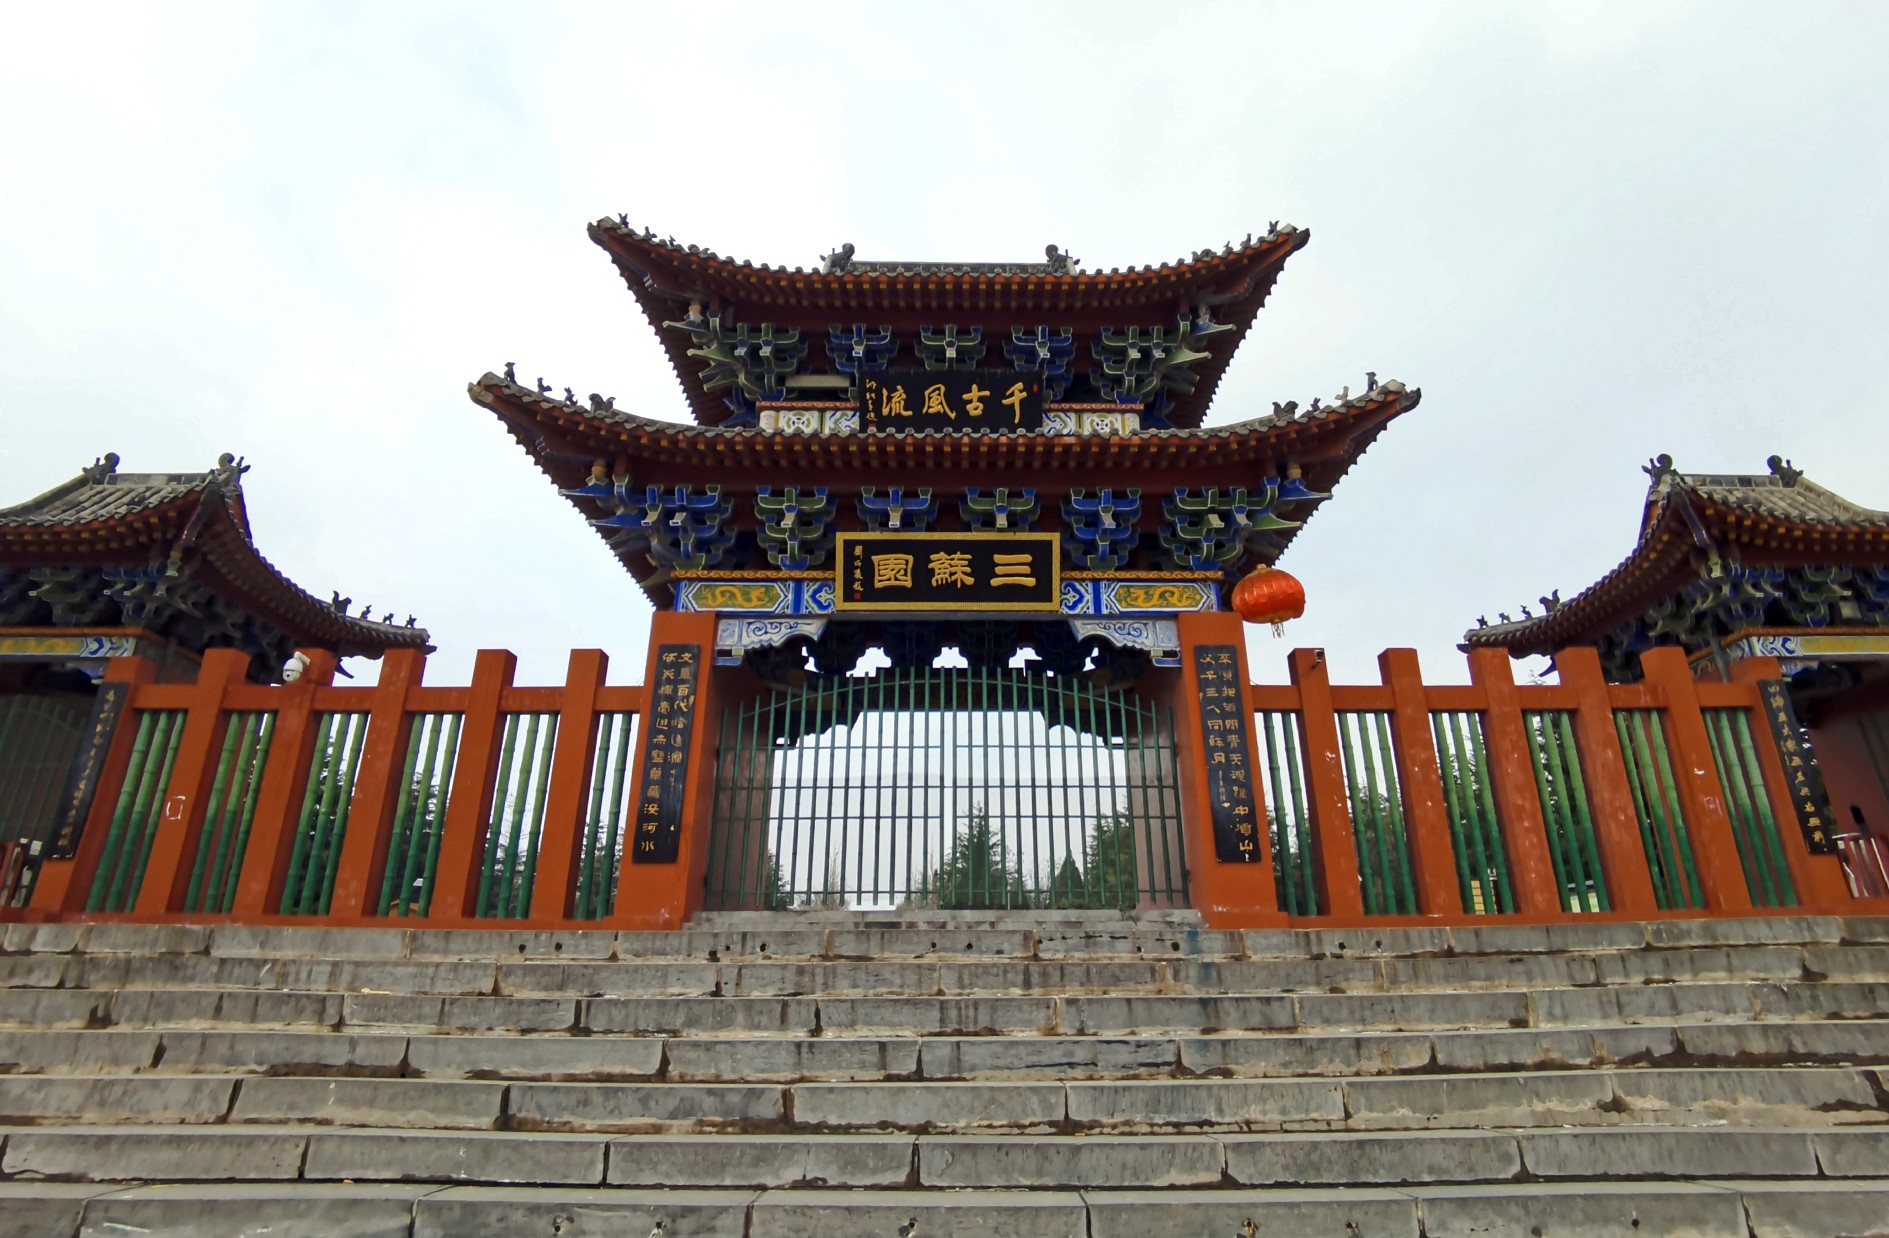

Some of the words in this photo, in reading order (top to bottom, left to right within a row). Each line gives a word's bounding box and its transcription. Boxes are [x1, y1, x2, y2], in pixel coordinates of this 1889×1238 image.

[882, 382, 1028, 424] 千古風流
[871, 551, 1036, 588] 三蘇園
